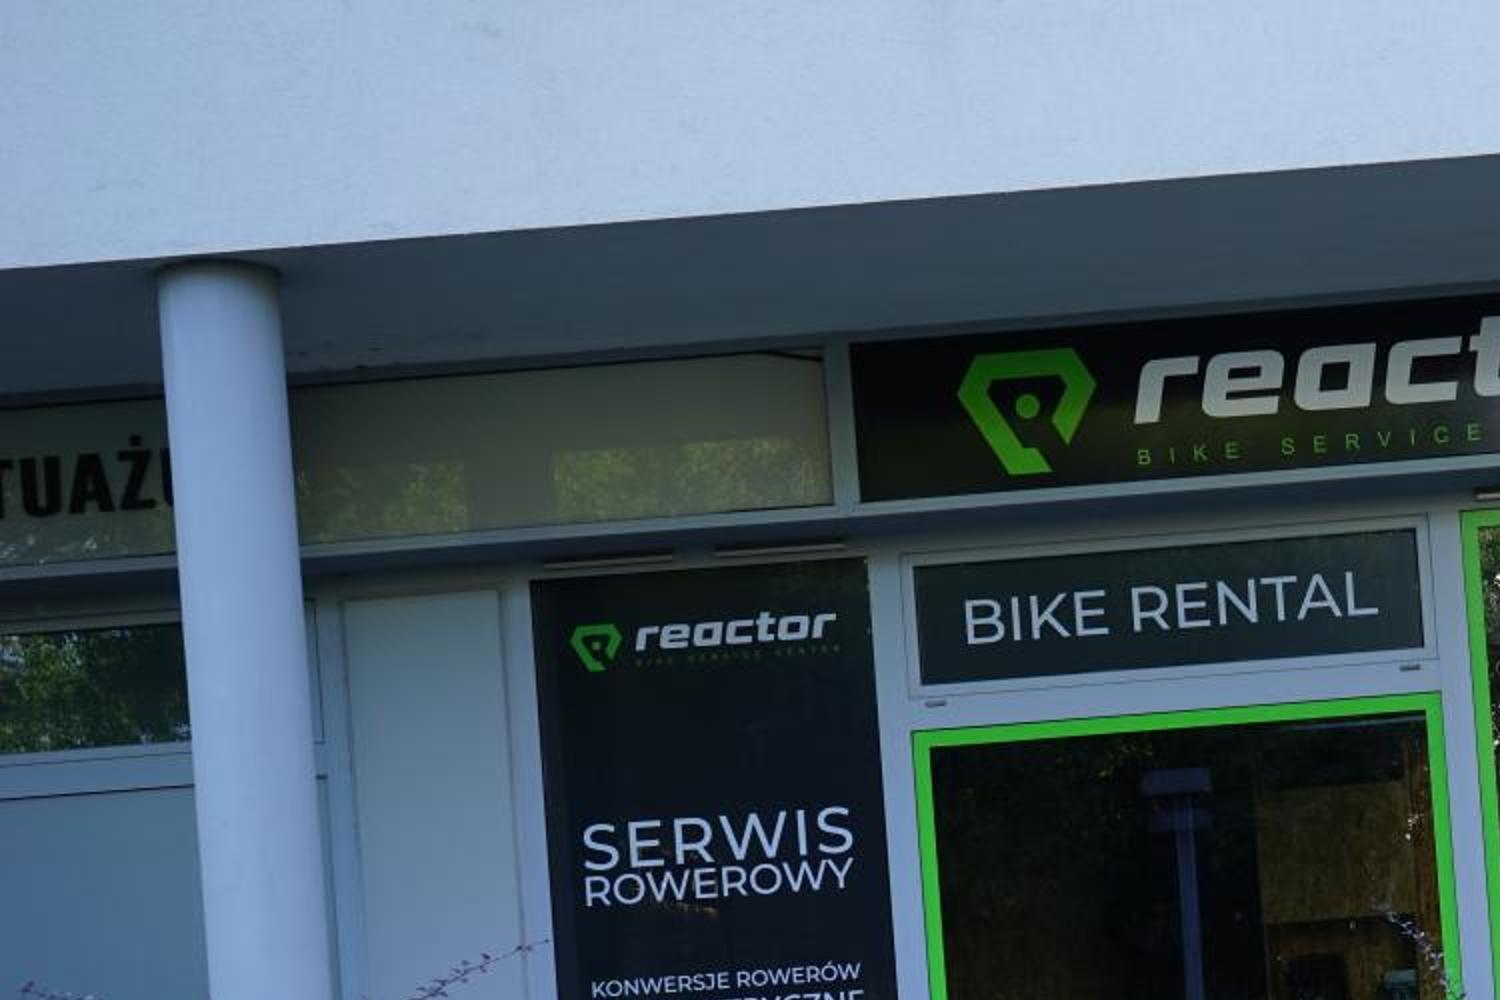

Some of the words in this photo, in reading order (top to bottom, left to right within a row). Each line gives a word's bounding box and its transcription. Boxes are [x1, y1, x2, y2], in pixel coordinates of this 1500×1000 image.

[1137, 442, 1240, 466] BIKE
[1281, 423, 1482, 455] SERVICE
[635, 611, 837, 651] reactor
[965, 589, 1109, 645] BIKE
[1131, 571, 1379, 632] RENTAL
[582, 805, 854, 871] SERWIS
[584, 857, 854, 907] ROWEROWY
[591, 972, 730, 999] KONWERSJE
[736, 961, 861, 988] ROWERÓW
